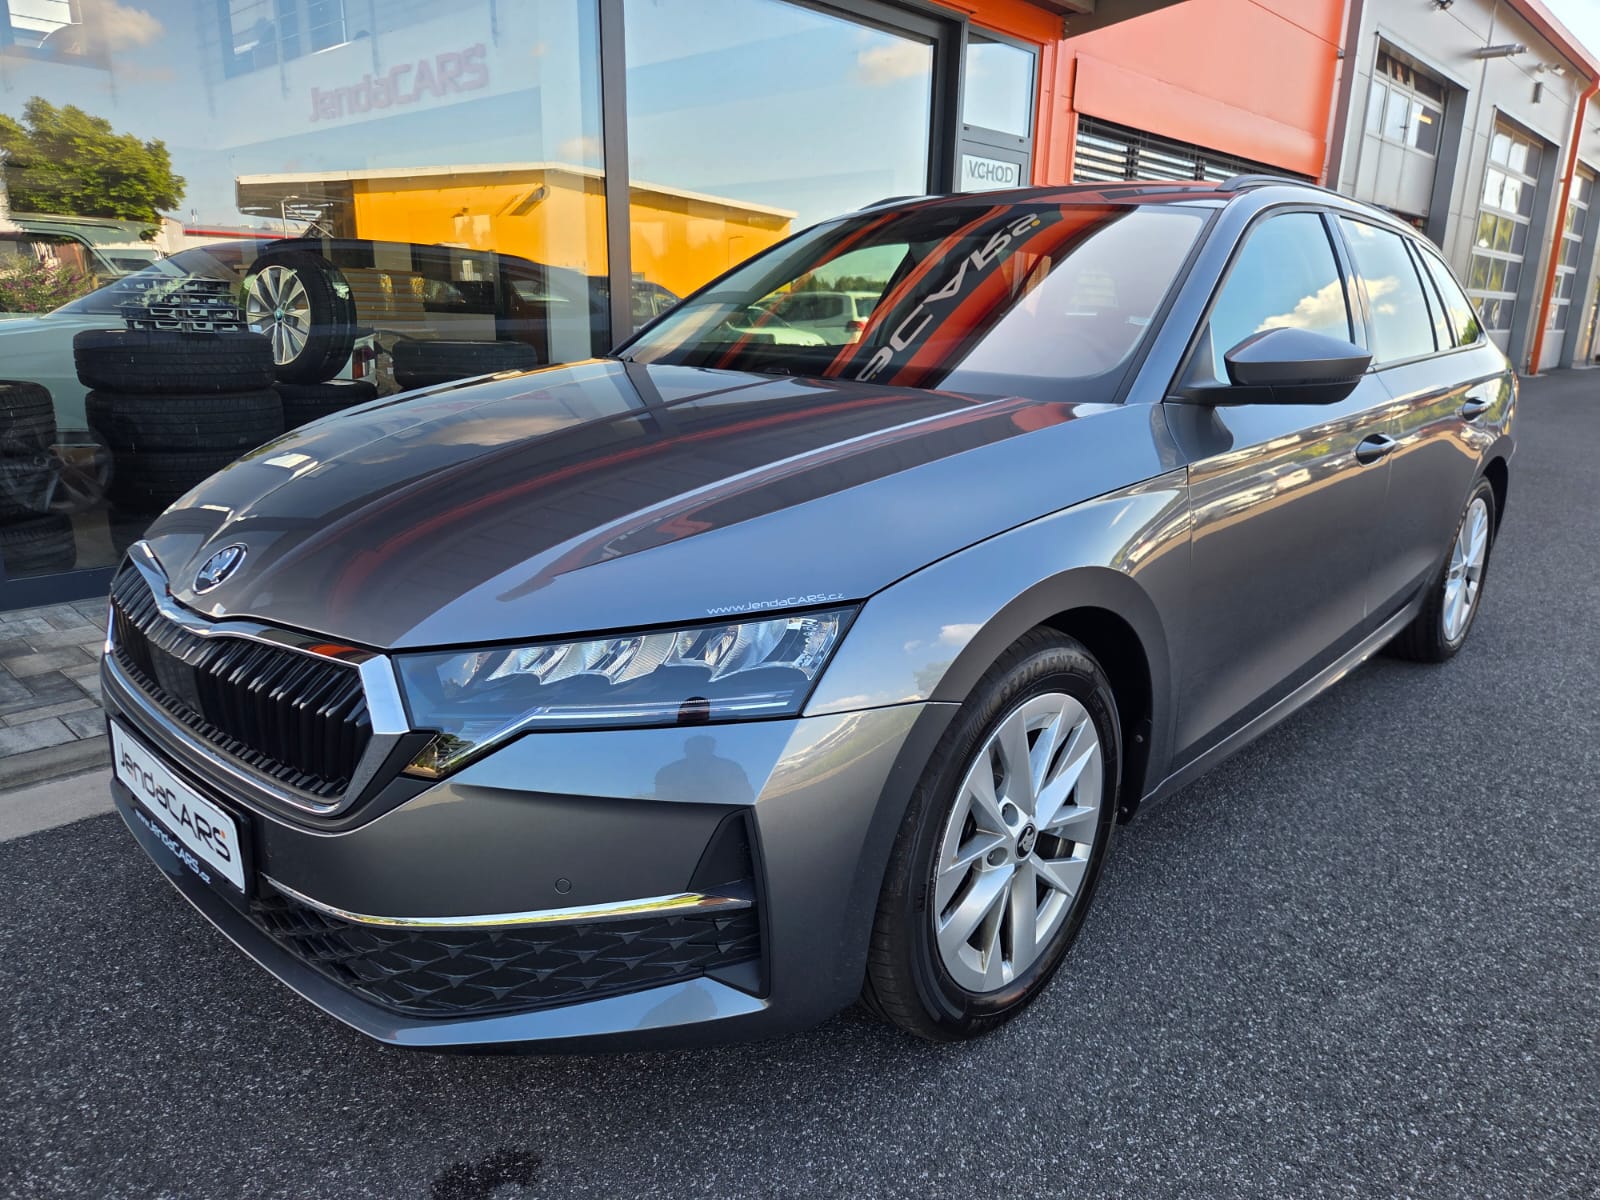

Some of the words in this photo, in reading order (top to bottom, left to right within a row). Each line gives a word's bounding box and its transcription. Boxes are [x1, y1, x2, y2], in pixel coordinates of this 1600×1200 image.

[968, 159, 1014, 183] VCHOD
[706, 592, 845, 615] www.JendaCARS.cz
[120, 742, 232, 863] JendaCARS
